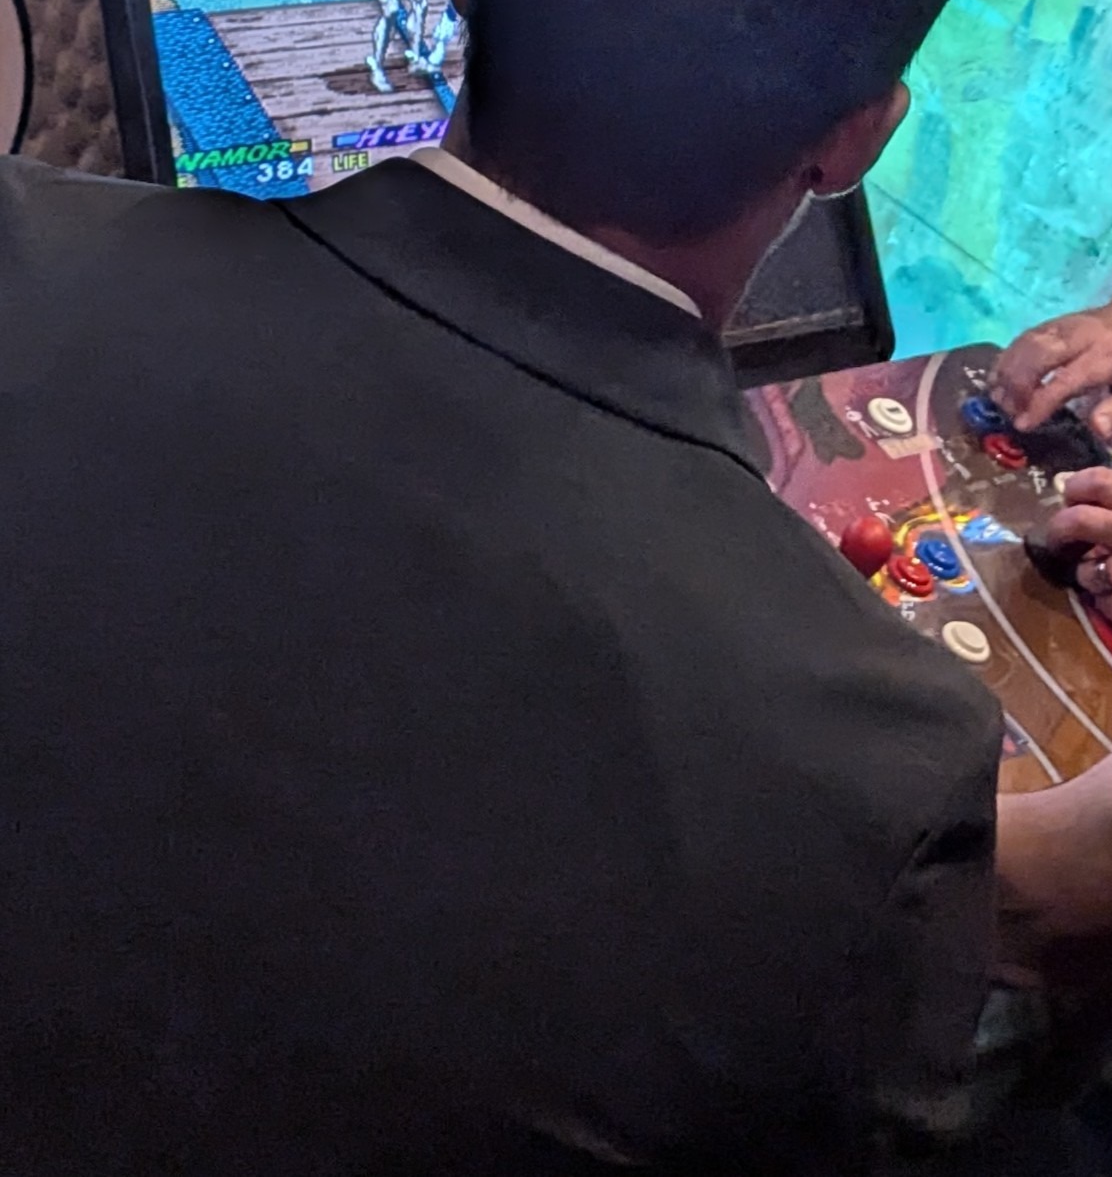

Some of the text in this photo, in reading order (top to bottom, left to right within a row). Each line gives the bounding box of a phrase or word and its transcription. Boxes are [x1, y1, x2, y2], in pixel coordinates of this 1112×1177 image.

[176, 140, 292, 171] NAMOR
[332, 152, 370, 172] LIFE
[256, 157, 314, 183] 384
